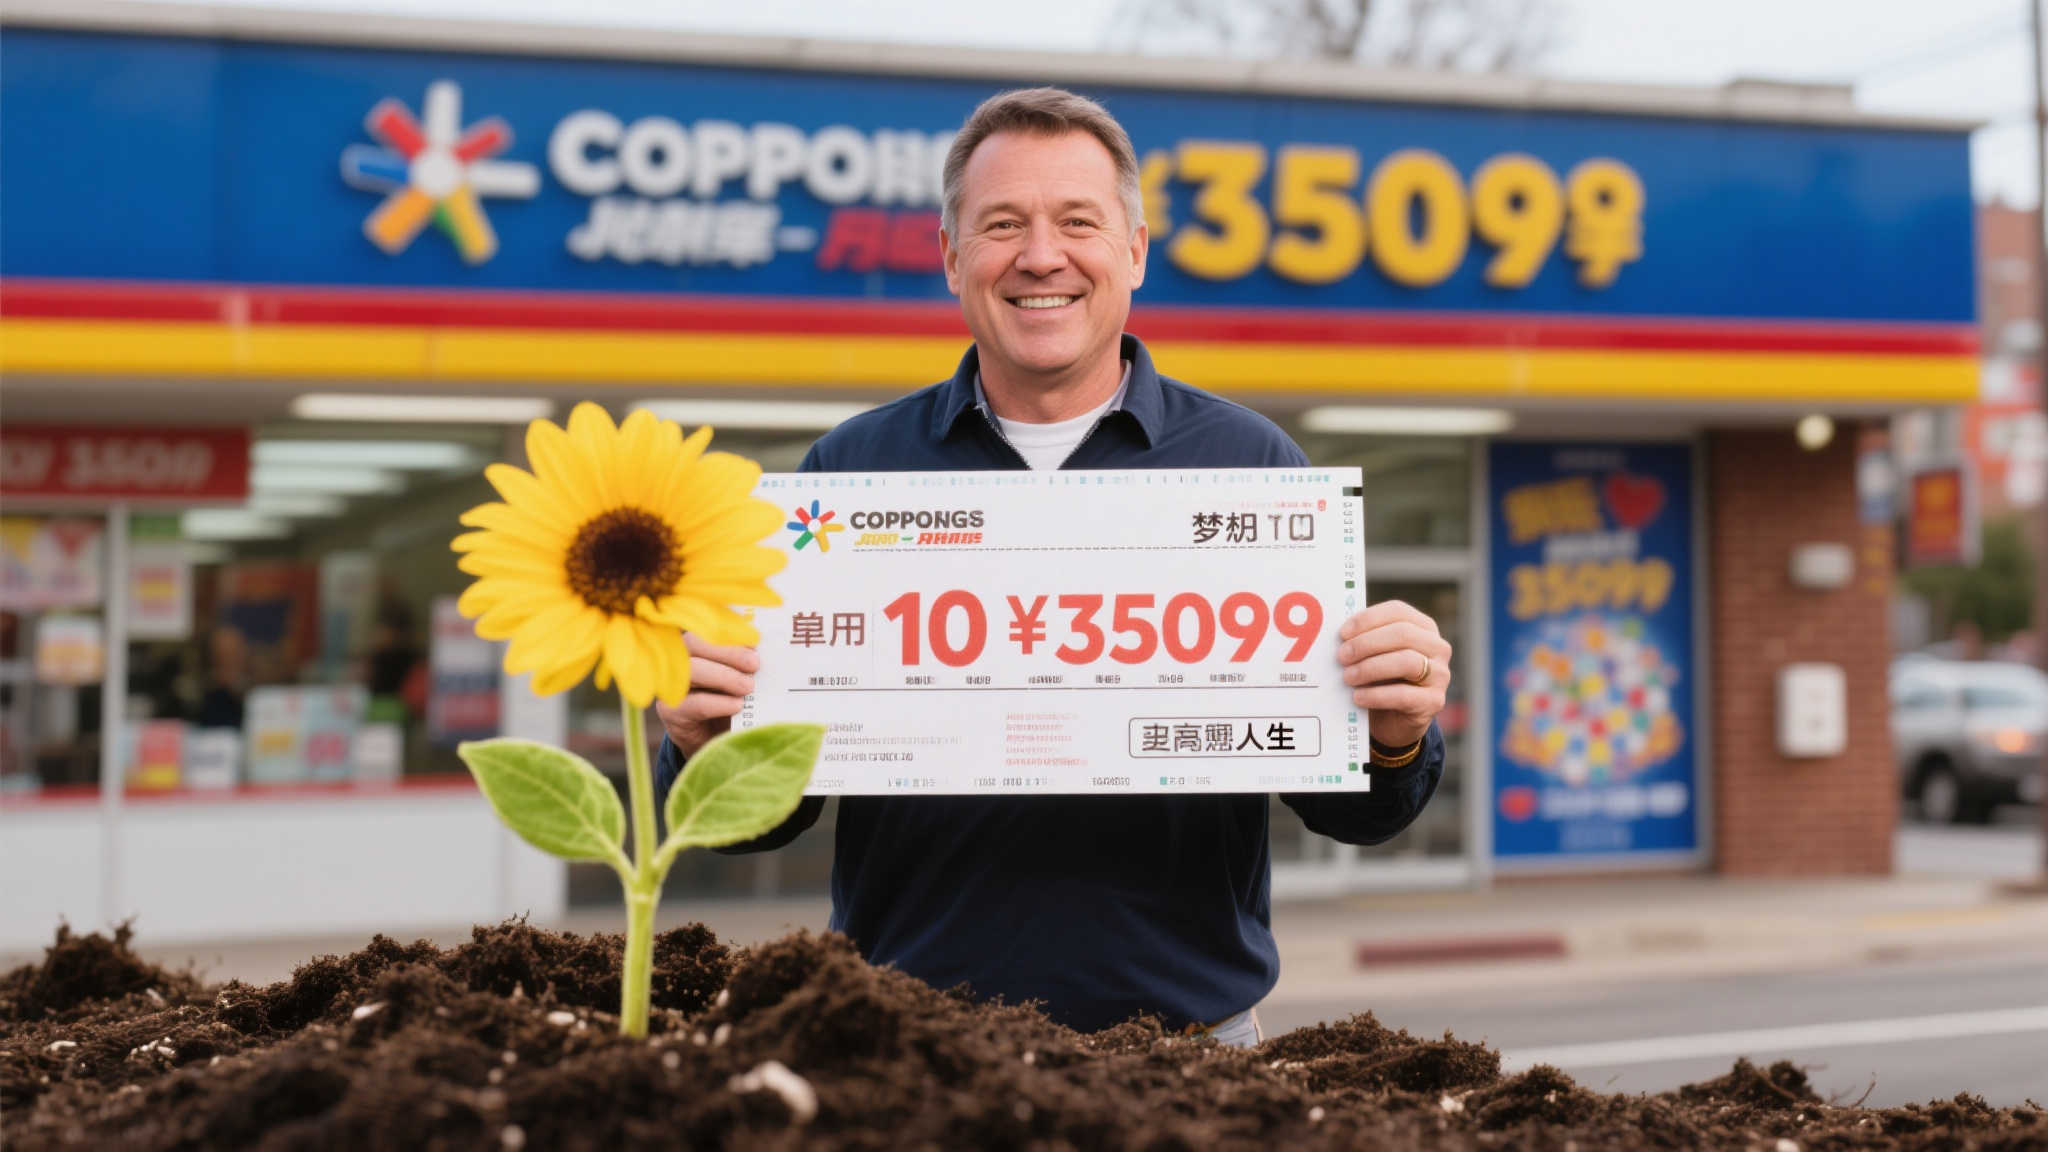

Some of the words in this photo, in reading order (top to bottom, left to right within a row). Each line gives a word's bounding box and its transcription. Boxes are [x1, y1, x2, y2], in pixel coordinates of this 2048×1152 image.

[850, 510, 984, 530] COPPONGS
[883, 589, 988, 668] 10
[1006, 591, 1324, 666] ¥35099
